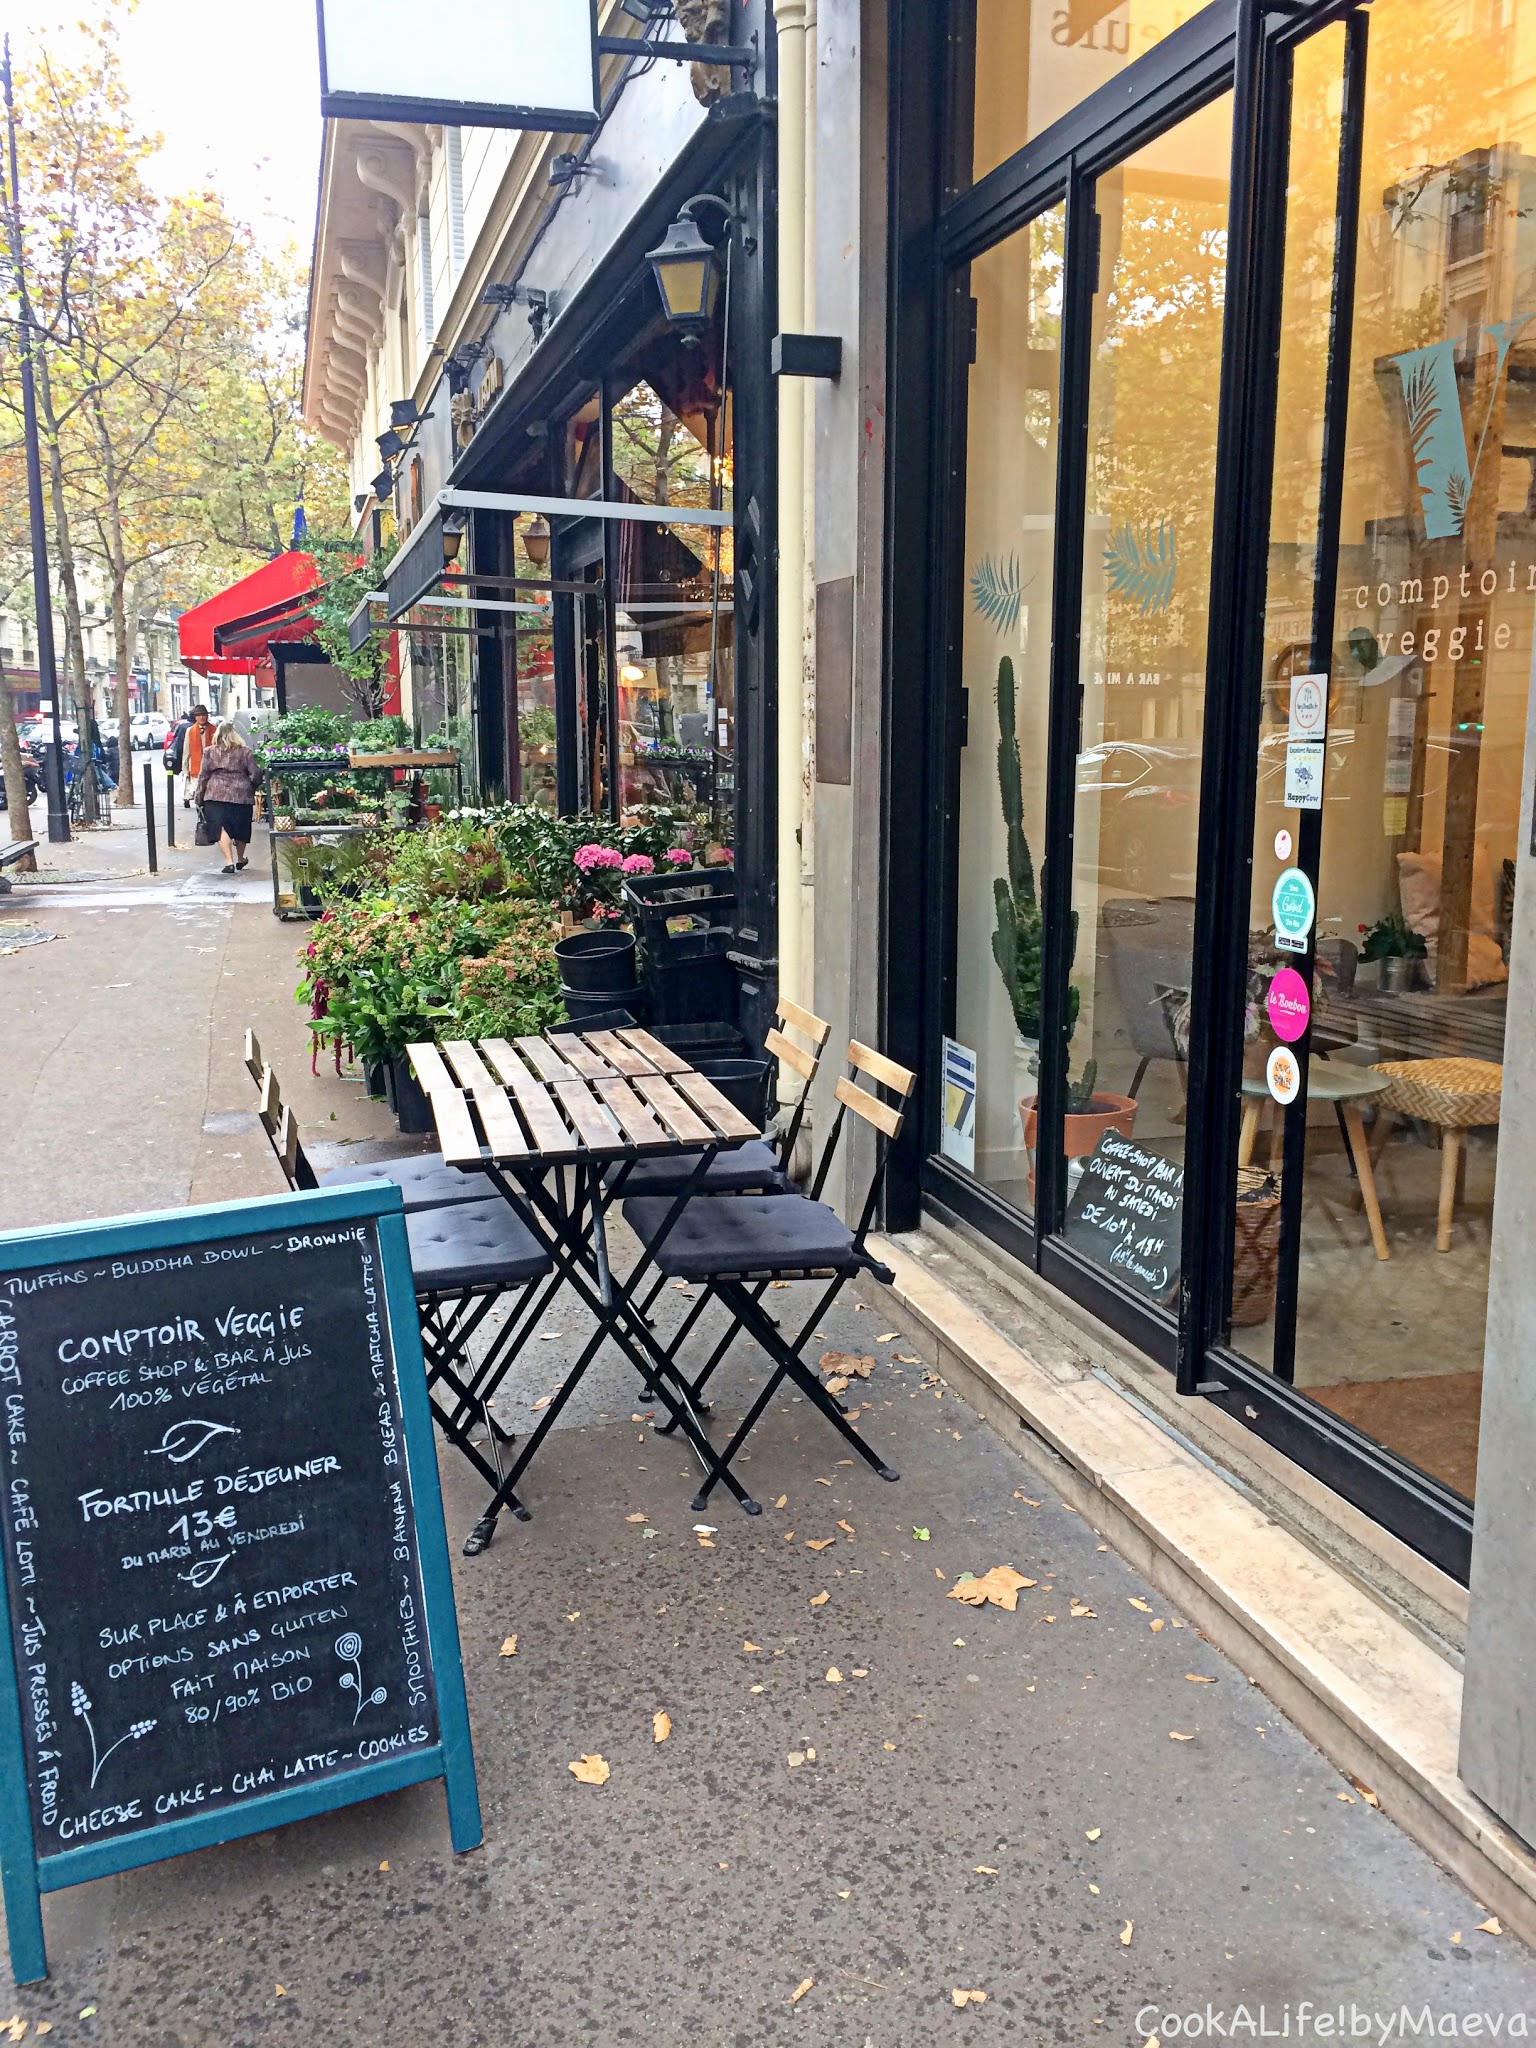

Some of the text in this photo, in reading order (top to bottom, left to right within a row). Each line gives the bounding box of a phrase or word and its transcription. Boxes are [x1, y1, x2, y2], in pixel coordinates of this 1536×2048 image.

[1356, 560, 1536, 609] comptoir
[1376, 618, 1511, 662] veggie
[1287, 792, 1319, 804] HappyCow
[1282, 895, 1305, 914] Good
[1269, 990, 1307, 1015] le Bonbon
[1089, 1157, 1131, 1182] OUVERT
[1124, 1175, 1144, 1193] DU
[1104, 1184, 1118, 1201] AU
[1081, 1202, 1106, 1224] DE
[112, 1254, 193, 1279] BUDDHA
[201, 1246, 263, 1265] BOWL
[286, 1226, 367, 1252] BROWNIE
[58, 1316, 205, 1362] COMPTOIR
[61, 1369, 131, 1395] COFFEE
[138, 1361, 188, 1382] SHOP
[194, 1357, 208, 1373] &
[214, 1348, 258, 1370] BAR
[278, 1343, 312, 1366] JUS
[109, 1370, 273, 1411] 100% VÉGÉTAL
[6, 1394, 27, 1445] CAKE
[380, 1402, 399, 1466] BREAD
[214, 1455, 342, 1495] DÉJEUNER
[10, 1478, 38, 1533] CAFÉ
[168, 1505, 238, 1542] 13€
[393, 1480, 411, 1561] BANANA
[121, 1554, 143, 1569] DU
[199, 1537, 221, 1553] AU
[227, 1514, 305, 1545] VENDREDI
[99, 1624, 142, 1649] SUR
[148, 1609, 208, 1637] PLACE
[215, 1603, 228, 1623] &
[253, 1571, 358, 1609] EMPORTER
[20, 1617, 47, 1657] JUS
[108, 1604, 348, 1679] OPTIONS SANS GLUTEN
[27, 1663, 58, 1743] PRESSÉS
[184, 1676, 312, 1724] 80/90% BIO
[36, 1766, 60, 1827] FROID
[59, 1800, 143, 1839] CHEESE
[155, 1784, 205, 1814] CAKE
[283, 1750, 338, 1779] LATTE
[358, 1725, 430, 1760] COOKIES
